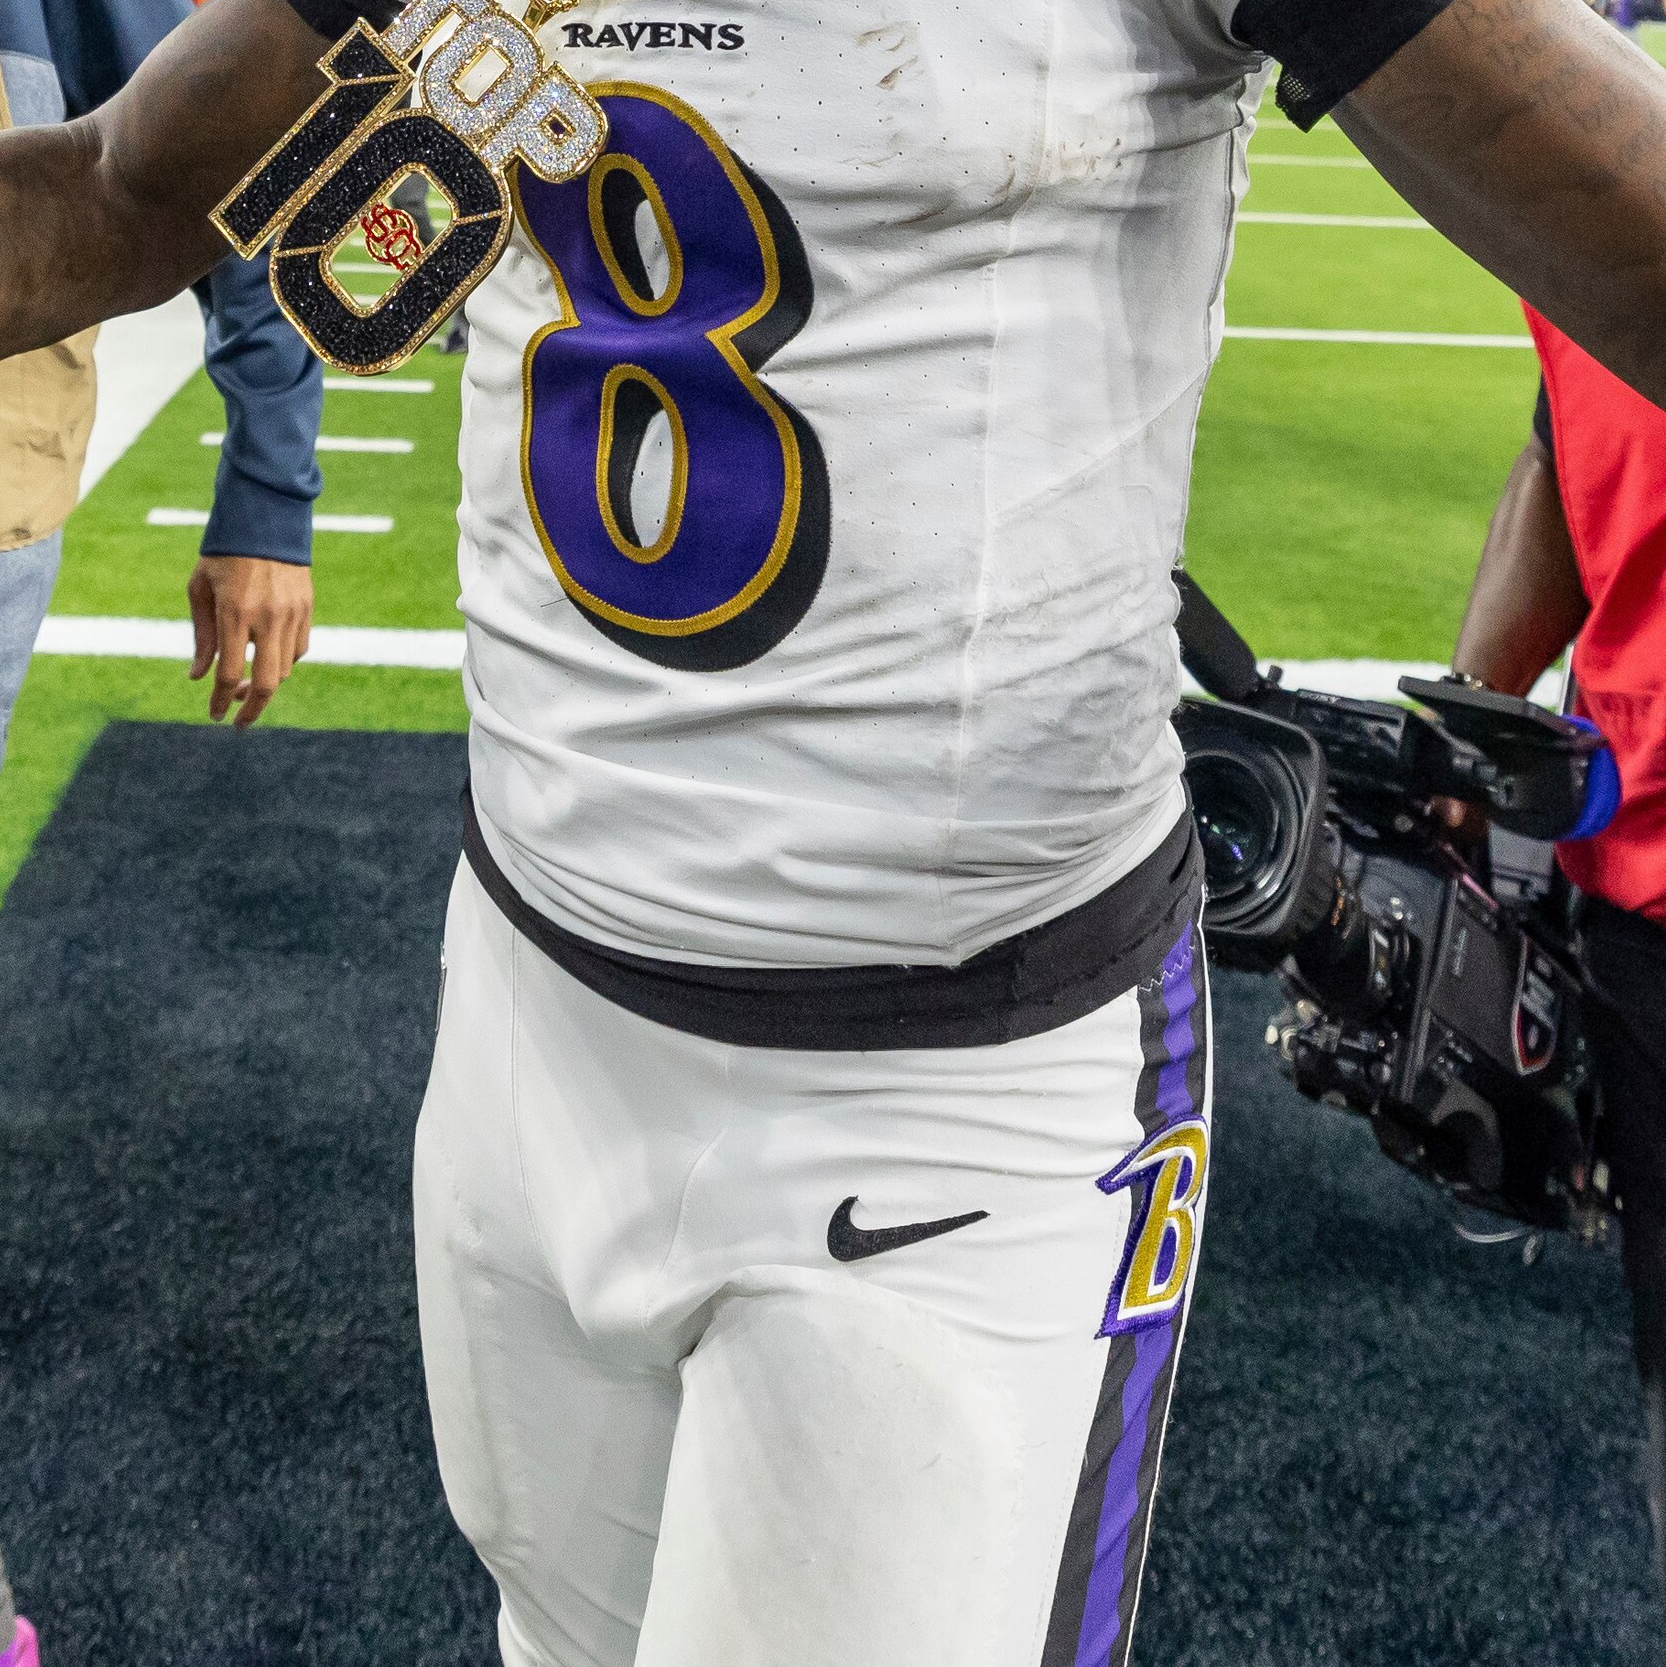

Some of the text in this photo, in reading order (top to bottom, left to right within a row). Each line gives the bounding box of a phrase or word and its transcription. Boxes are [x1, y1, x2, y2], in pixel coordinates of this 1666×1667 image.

[208, 17, 514, 376] 10
[561, 21, 745, 52] RAVENS
[515, 80, 831, 672] 8
